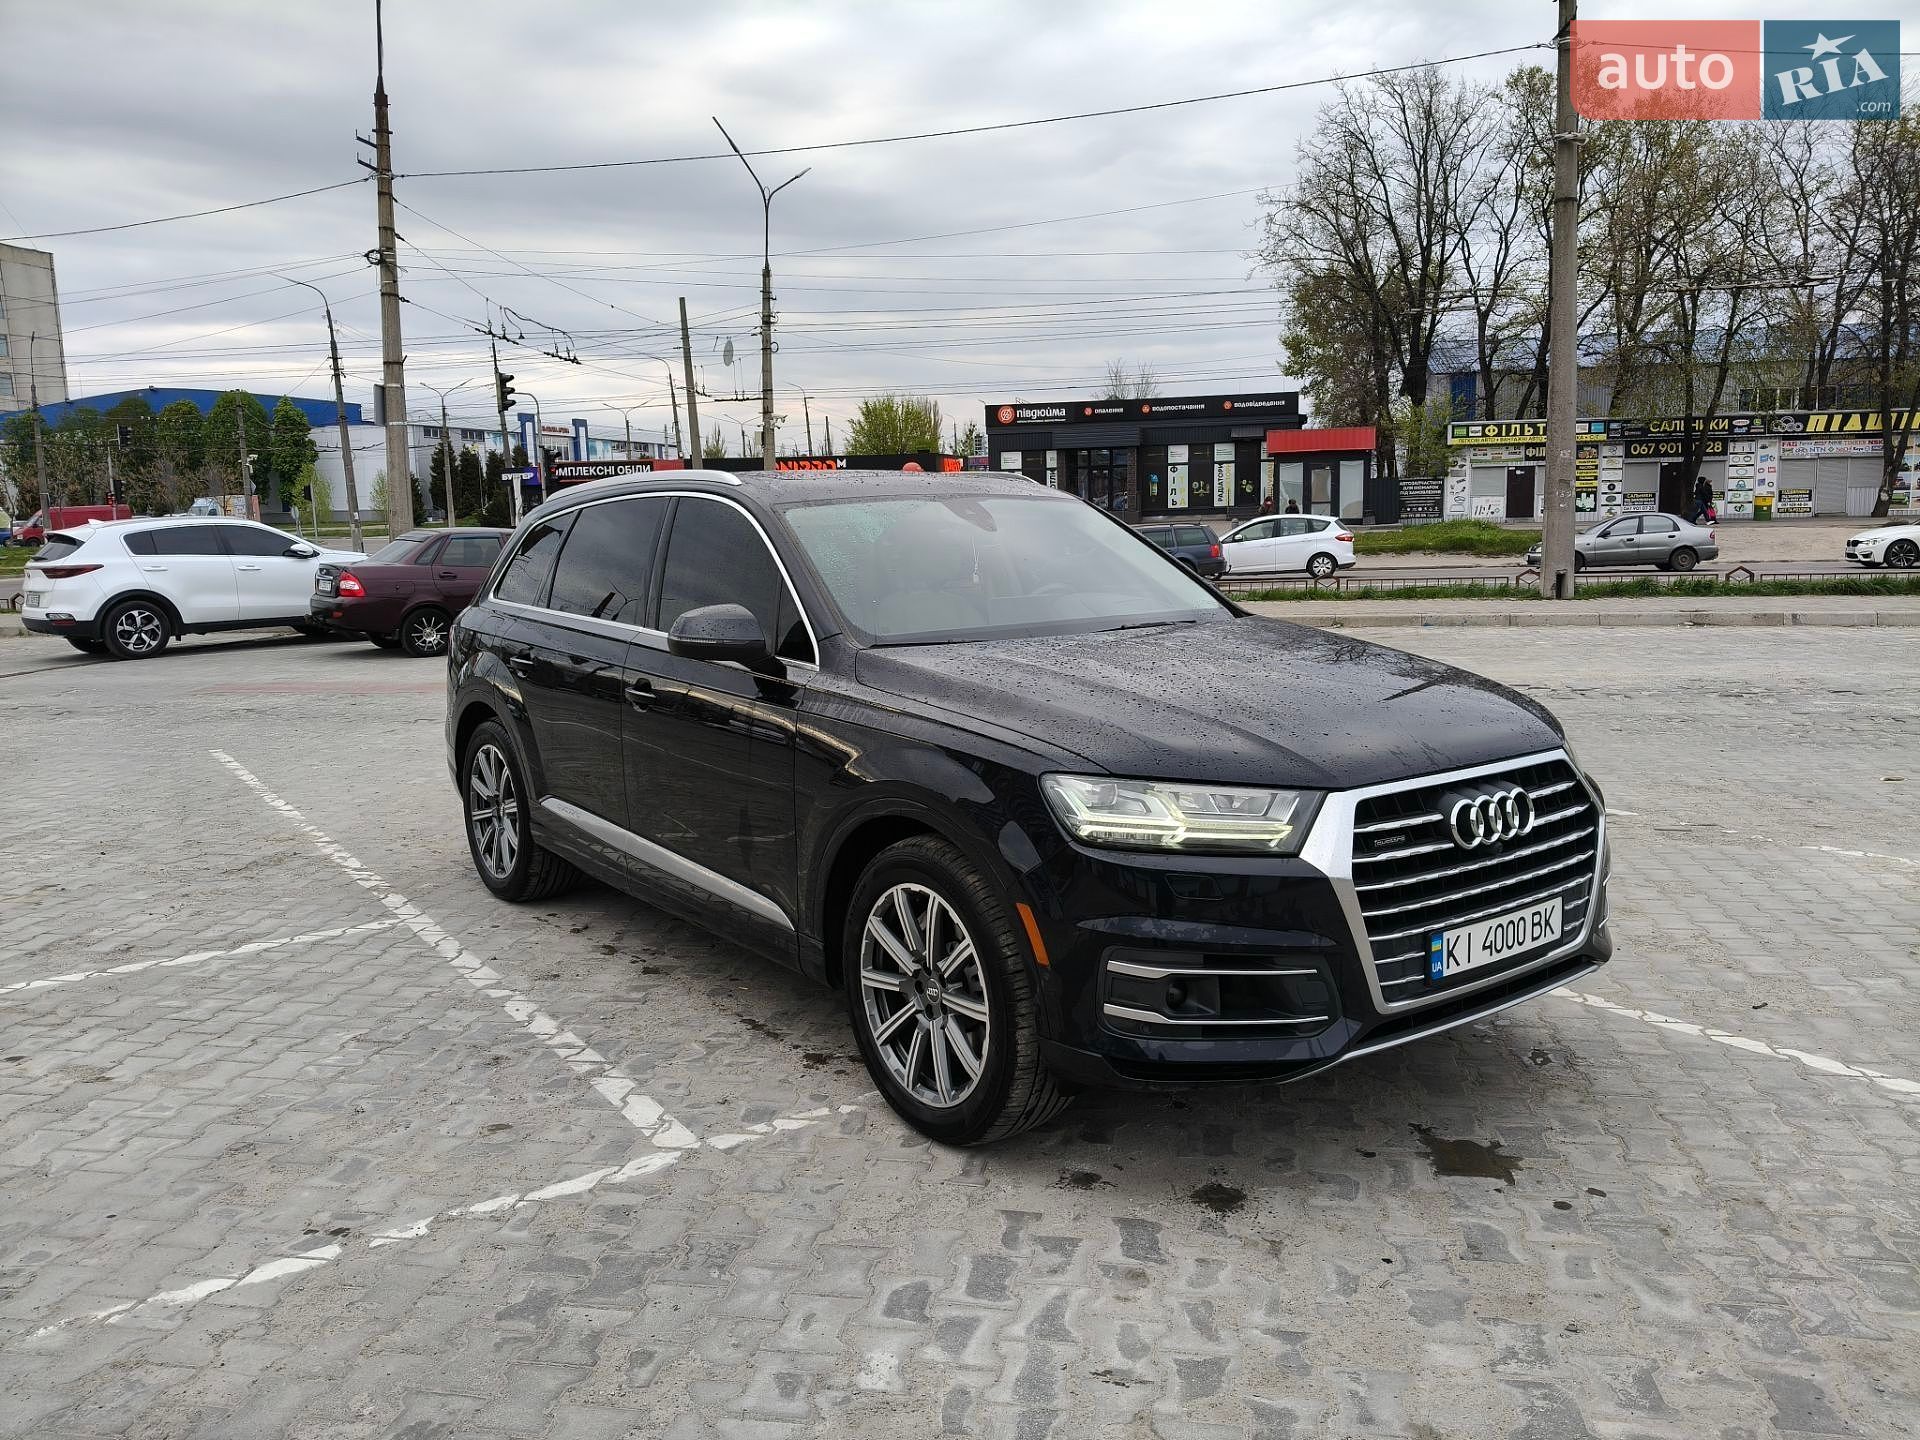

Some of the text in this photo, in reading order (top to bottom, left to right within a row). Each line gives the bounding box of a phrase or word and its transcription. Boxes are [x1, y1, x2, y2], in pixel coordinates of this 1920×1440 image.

[1631, 443, 1655, 455] 067
[1659, 442, 1682, 454] 901
[1705, 441, 1722, 453] 28
[1446, 905, 1556, 969] KI 4000 BK
[1432, 961, 1442, 973] UA
